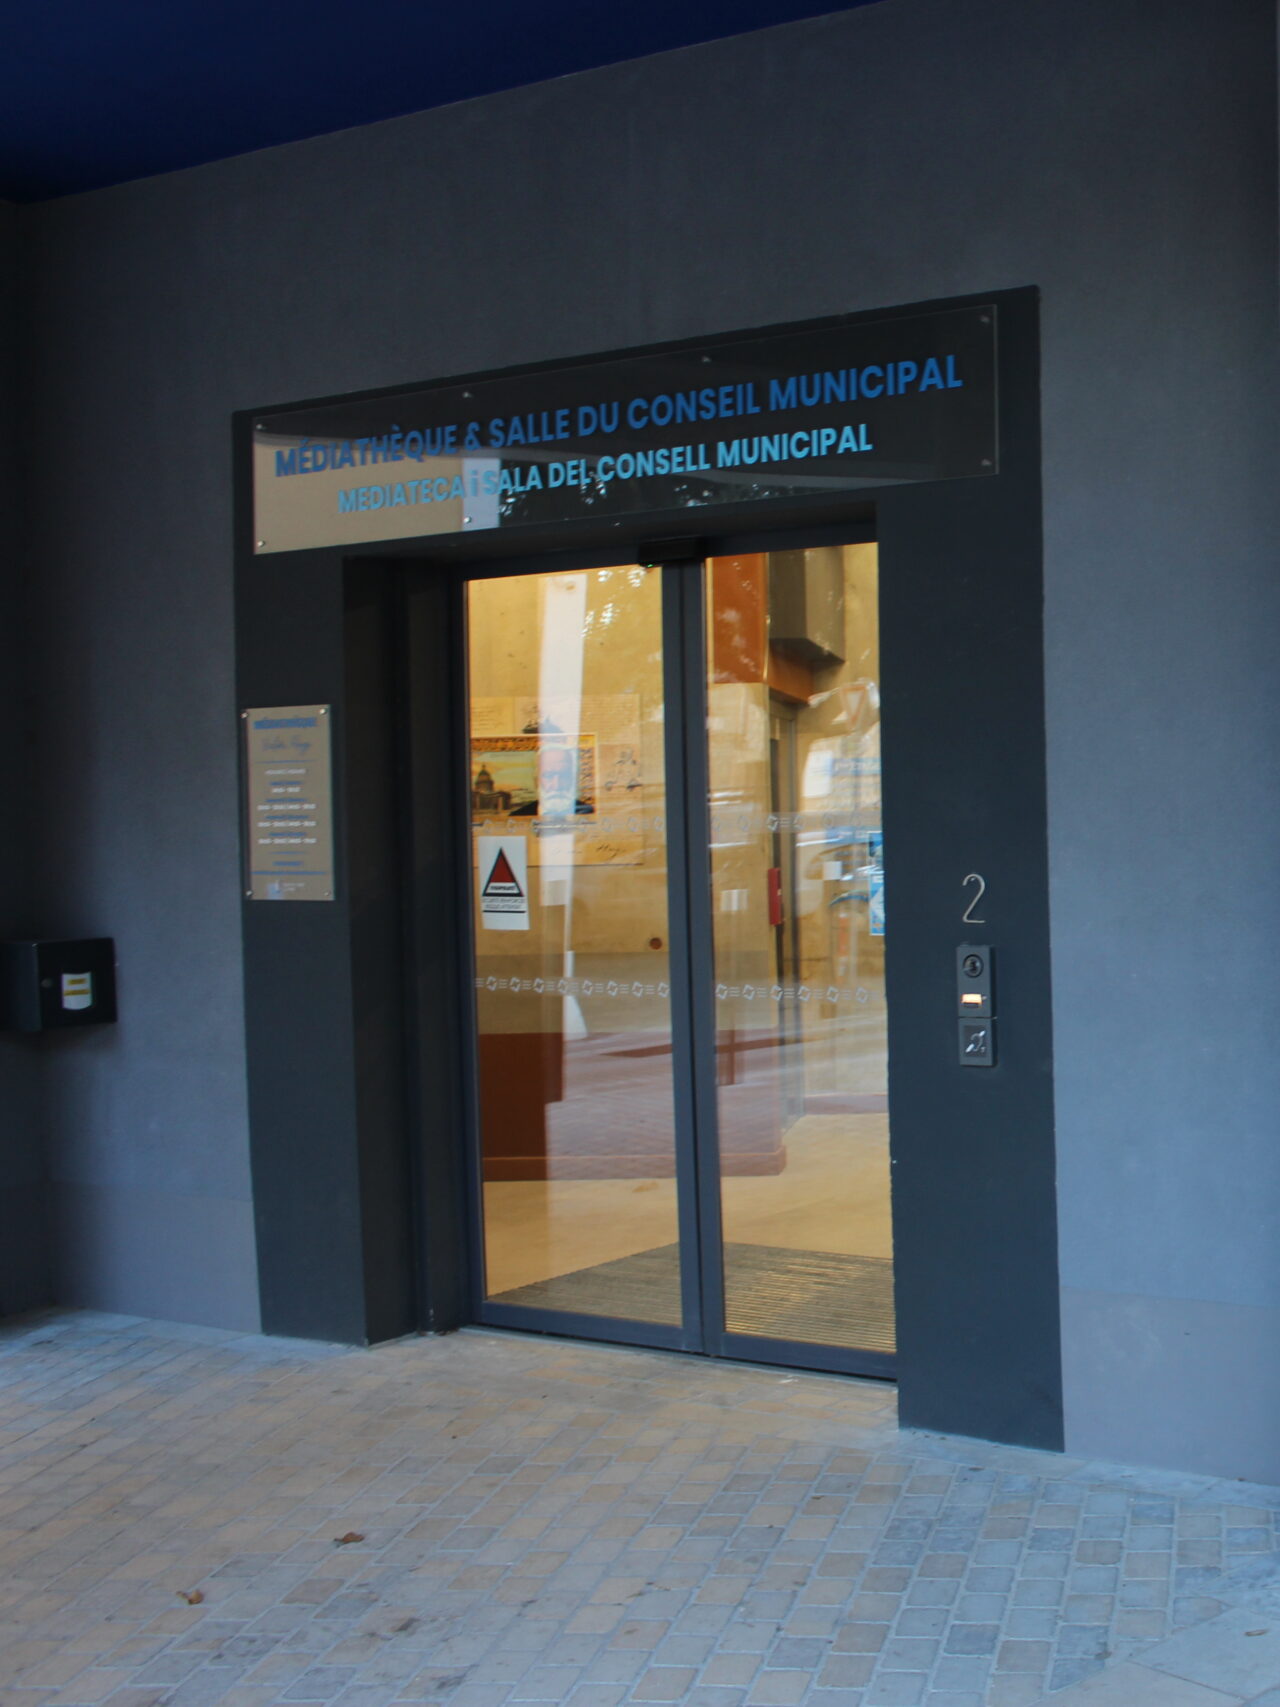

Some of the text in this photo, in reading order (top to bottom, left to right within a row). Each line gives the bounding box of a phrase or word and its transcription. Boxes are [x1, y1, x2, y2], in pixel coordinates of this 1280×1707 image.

[274, 354, 964, 478] MÉDIATHÈQUE & SALLE DU CONSEIL MUNICIPAL
[337, 423, 873, 513] MEDIATECA i SALA DEL CONSELL MUNICIPAL
[962, 873, 986, 924] 2
